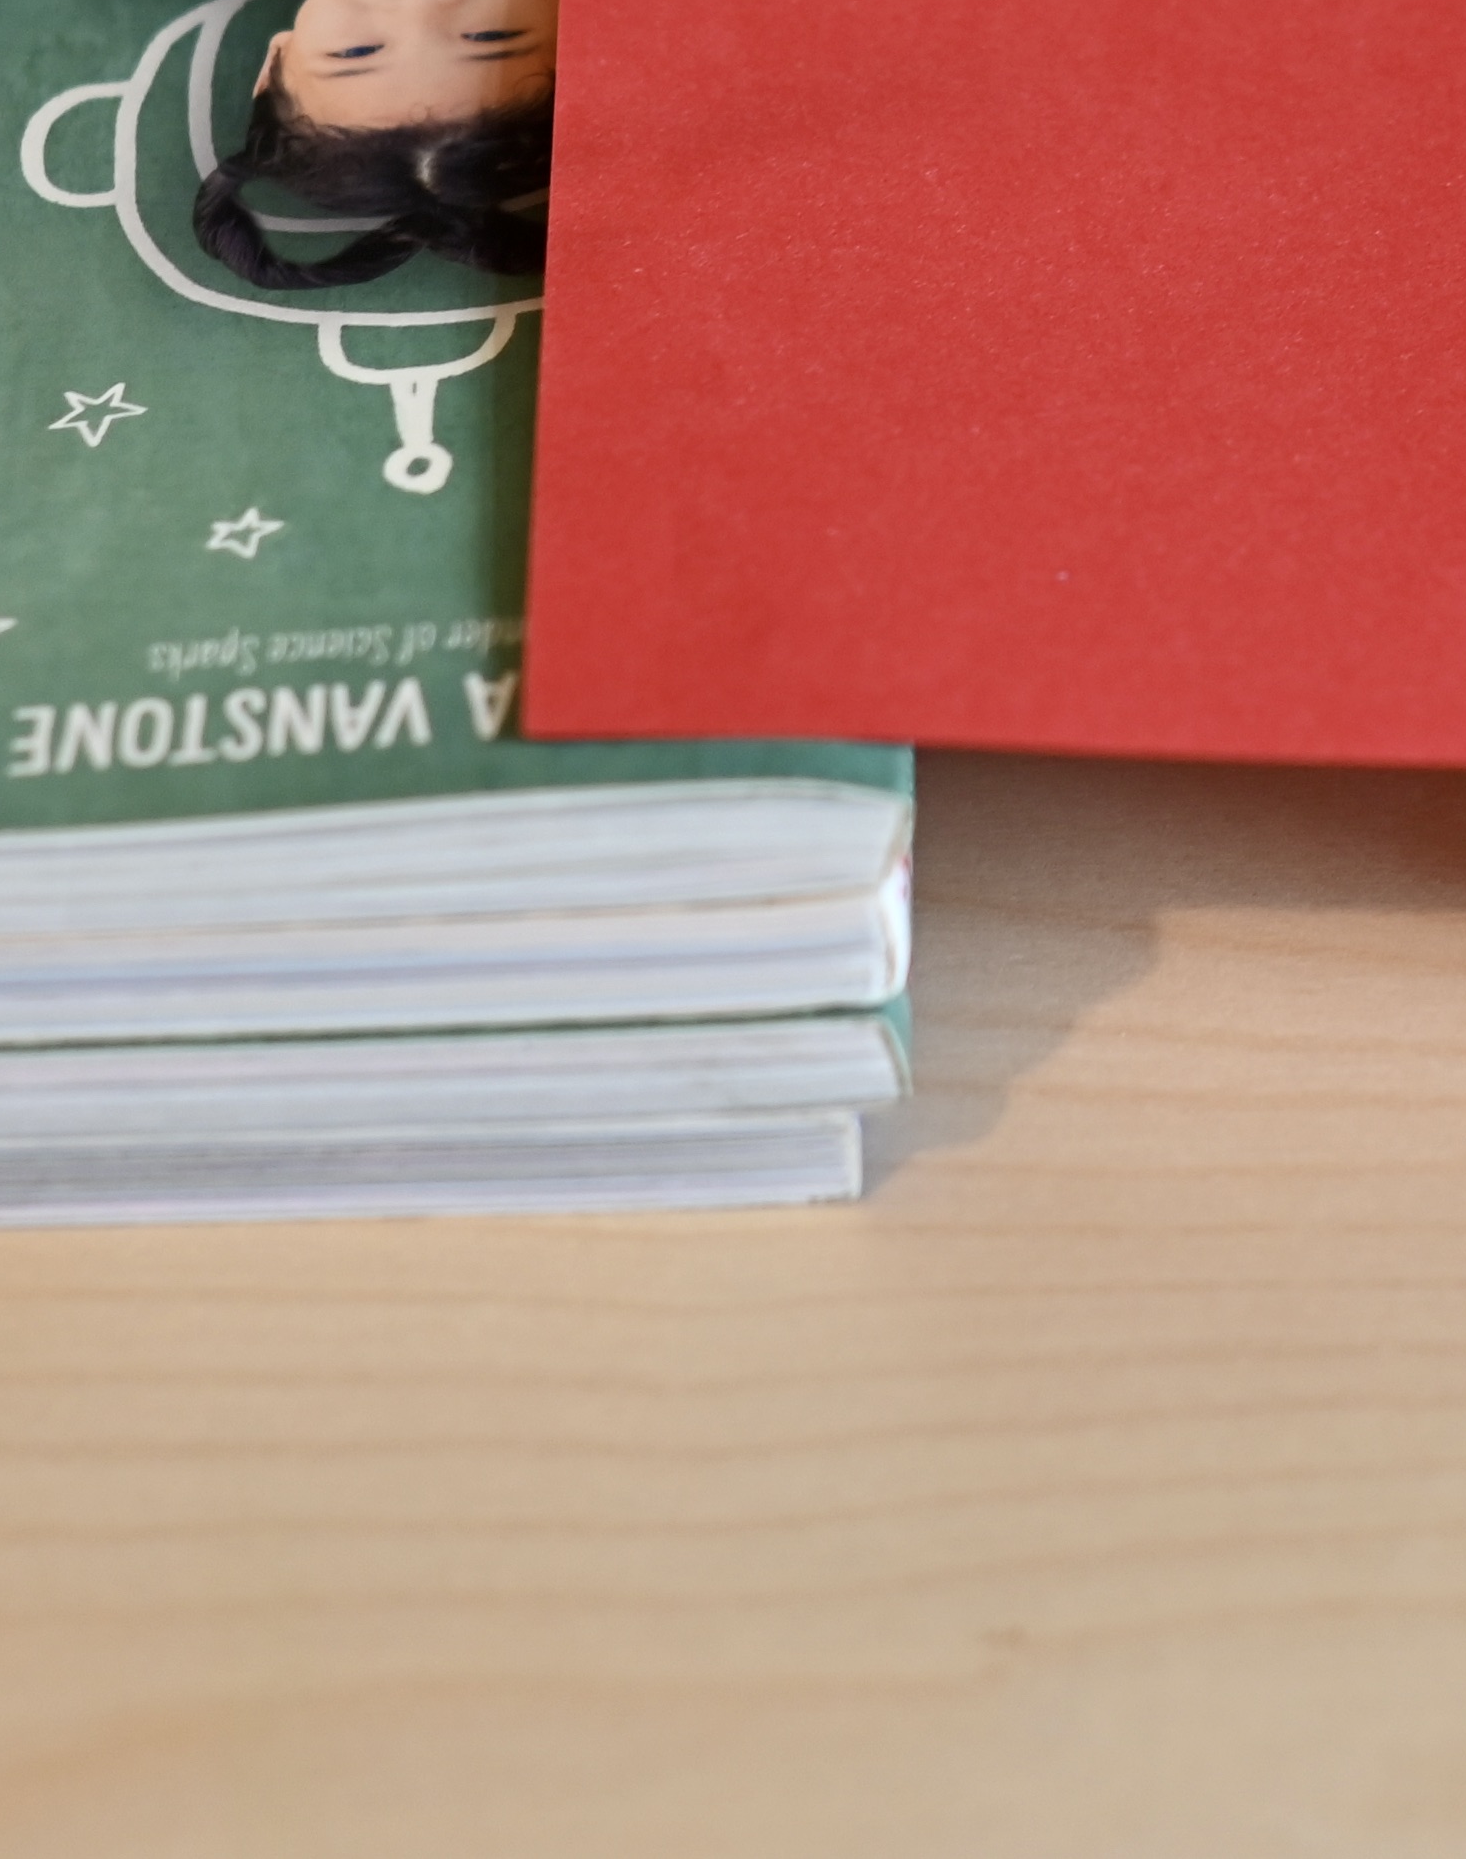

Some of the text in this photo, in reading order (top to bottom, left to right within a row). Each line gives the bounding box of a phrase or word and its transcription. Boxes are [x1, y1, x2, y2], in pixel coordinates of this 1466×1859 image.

[145, 626, 261, 682] Sparks
[265, 622, 392, 664] Science
[397, 621, 438, 667] of
[5, 674, 432, 779] VANSTONE
